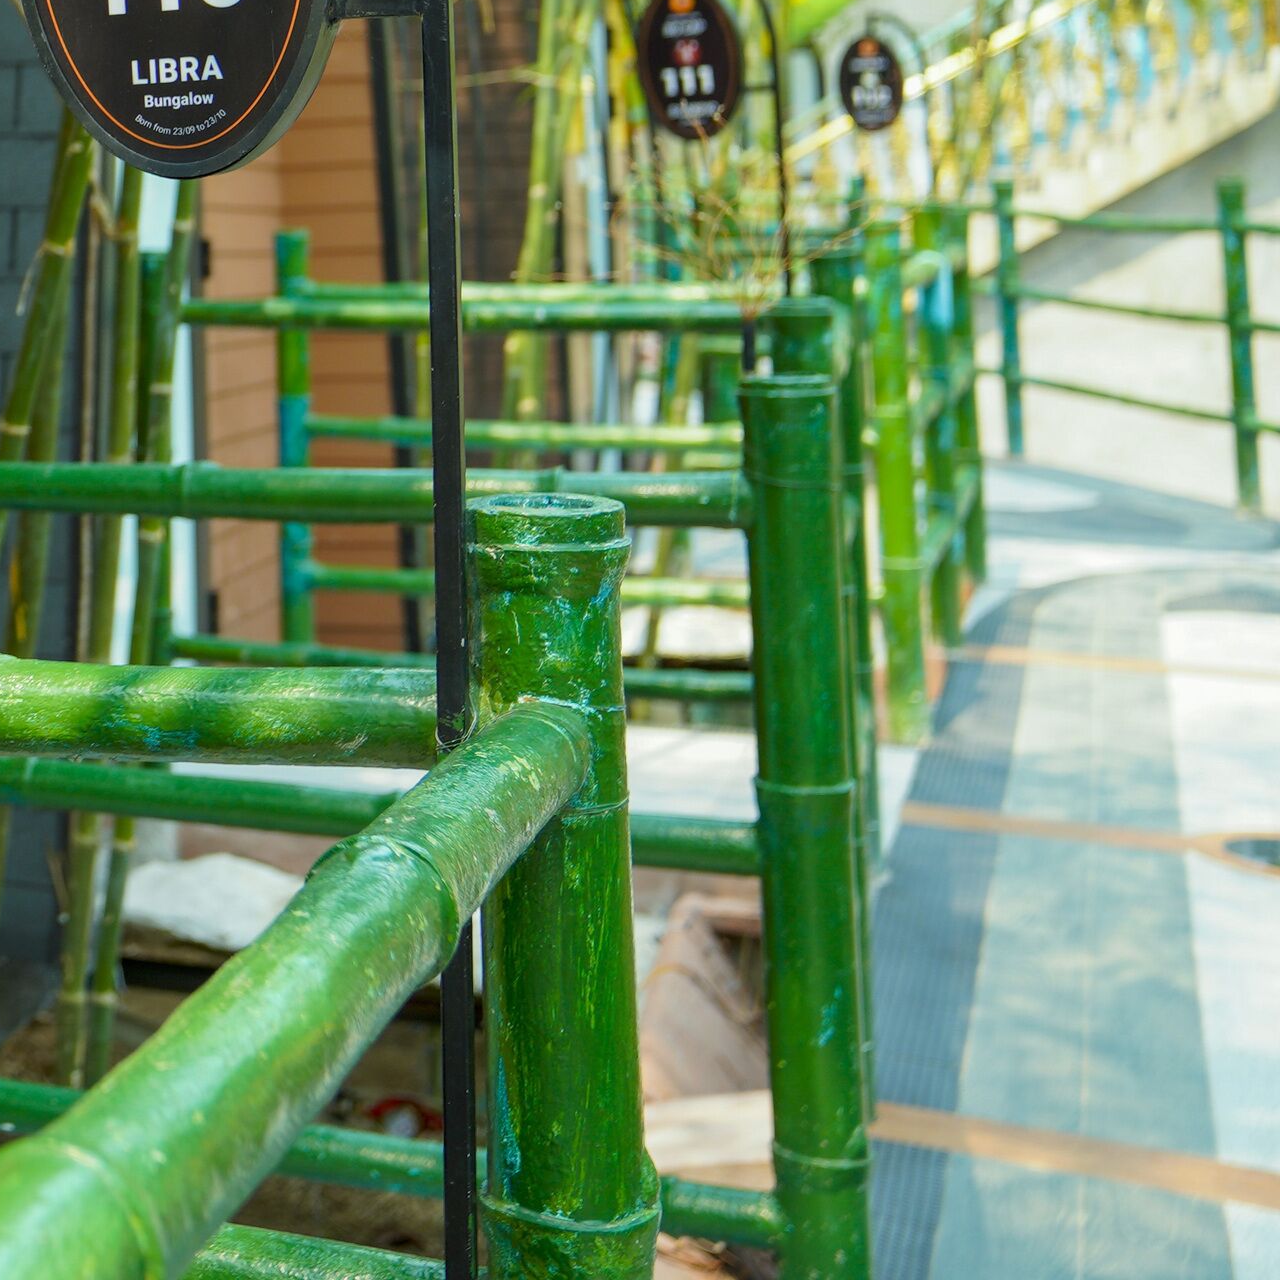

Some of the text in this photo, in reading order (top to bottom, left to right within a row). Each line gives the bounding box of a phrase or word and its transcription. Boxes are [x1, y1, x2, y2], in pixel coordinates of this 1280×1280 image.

[131, 54, 224, 86] LIBRA
[660, 64, 715, 97] 111
[144, 91, 214, 110] Bungalow
[135, 108, 227, 136] Born from 23/09 to 23/10
